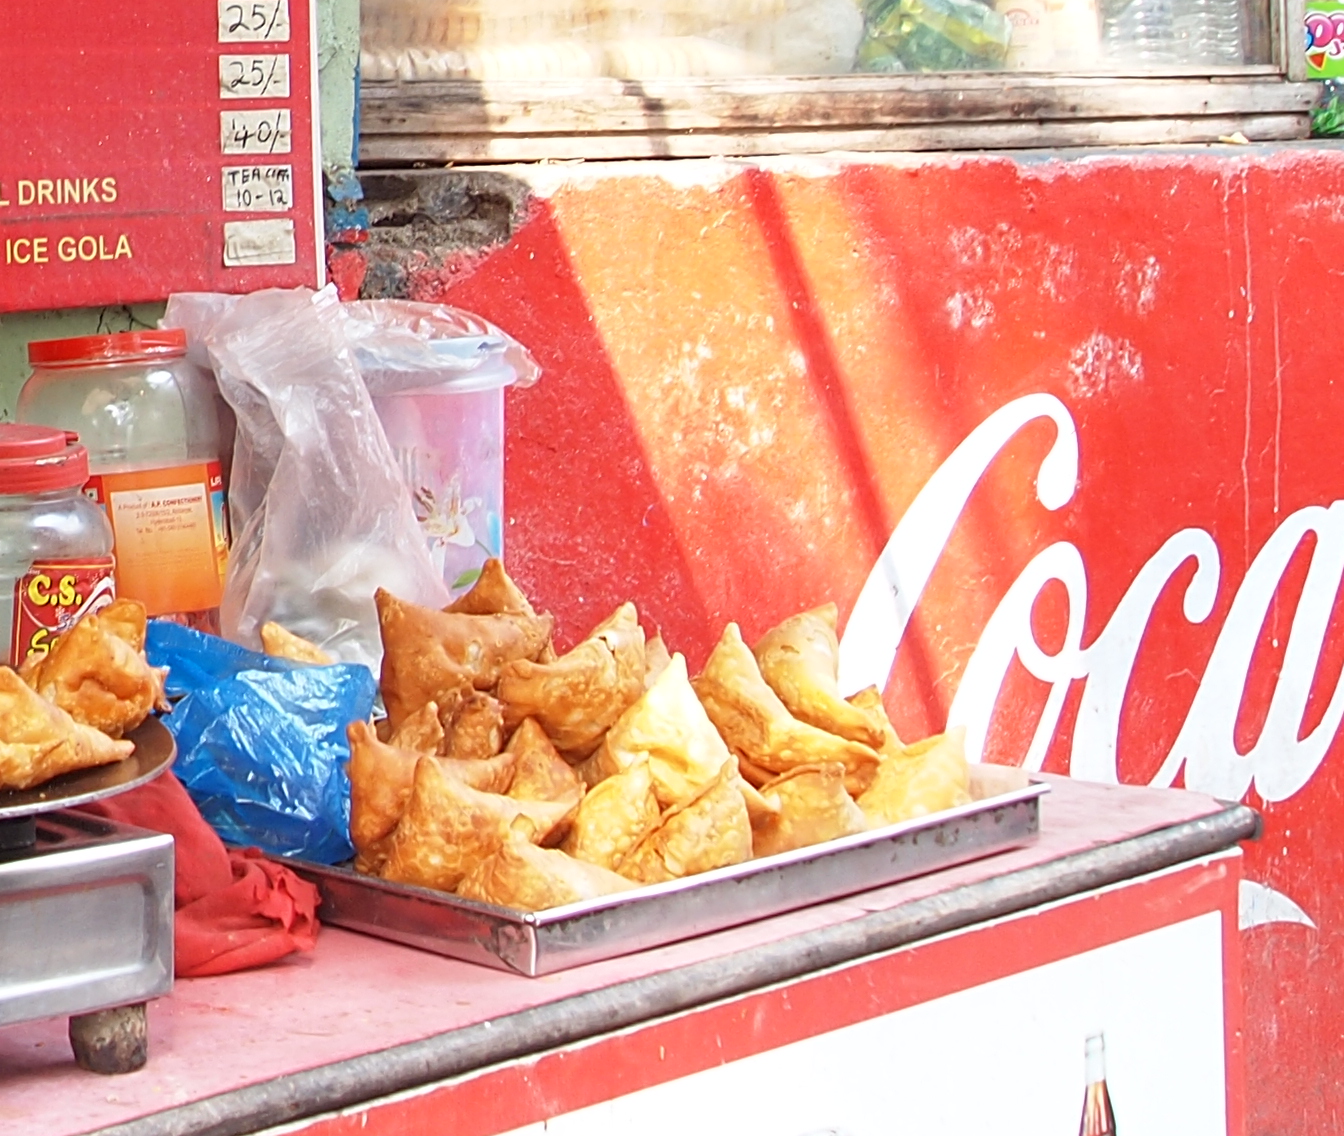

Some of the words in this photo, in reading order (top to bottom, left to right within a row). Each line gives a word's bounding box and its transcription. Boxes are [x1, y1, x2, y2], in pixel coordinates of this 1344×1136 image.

[17, 176, 118, 206] DRINKS
[227, 168, 261, 186] TEA
[6, 237, 49, 264] ICE
[57, 233, 133, 262] GOLA
[27, 574, 83, 607] C.S.
